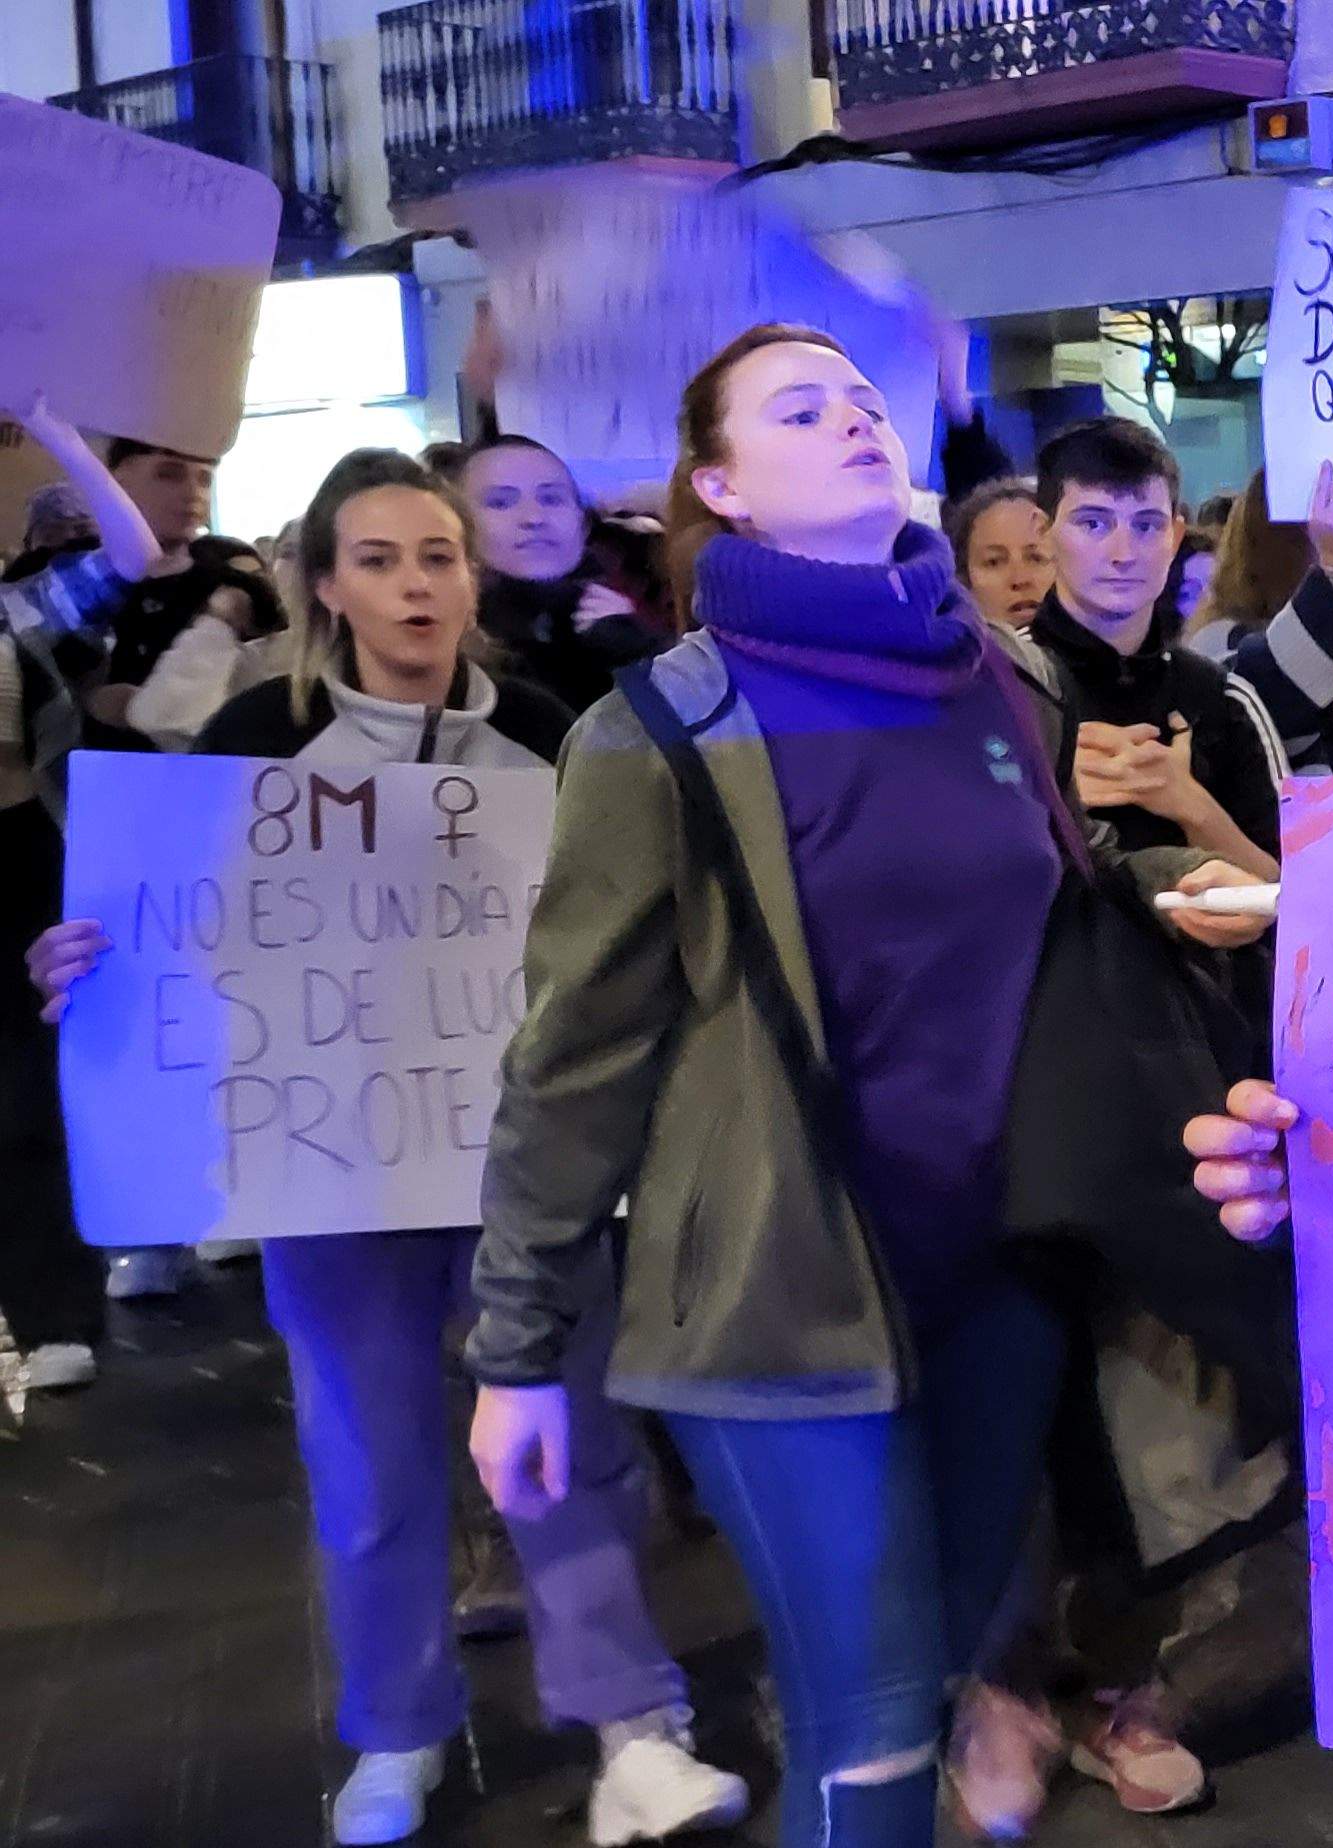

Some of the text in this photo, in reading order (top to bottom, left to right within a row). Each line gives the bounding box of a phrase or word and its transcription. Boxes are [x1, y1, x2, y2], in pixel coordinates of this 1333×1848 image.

[248, 766, 377, 857] 8M
[135, 876, 227, 953] NO
[248, 877, 328, 949] ES
[349, 881, 419, 943] UN
[156, 970, 270, 1072] ES
[303, 967, 392, 1046] DE
[209, 1067, 500, 1195] PROTE
